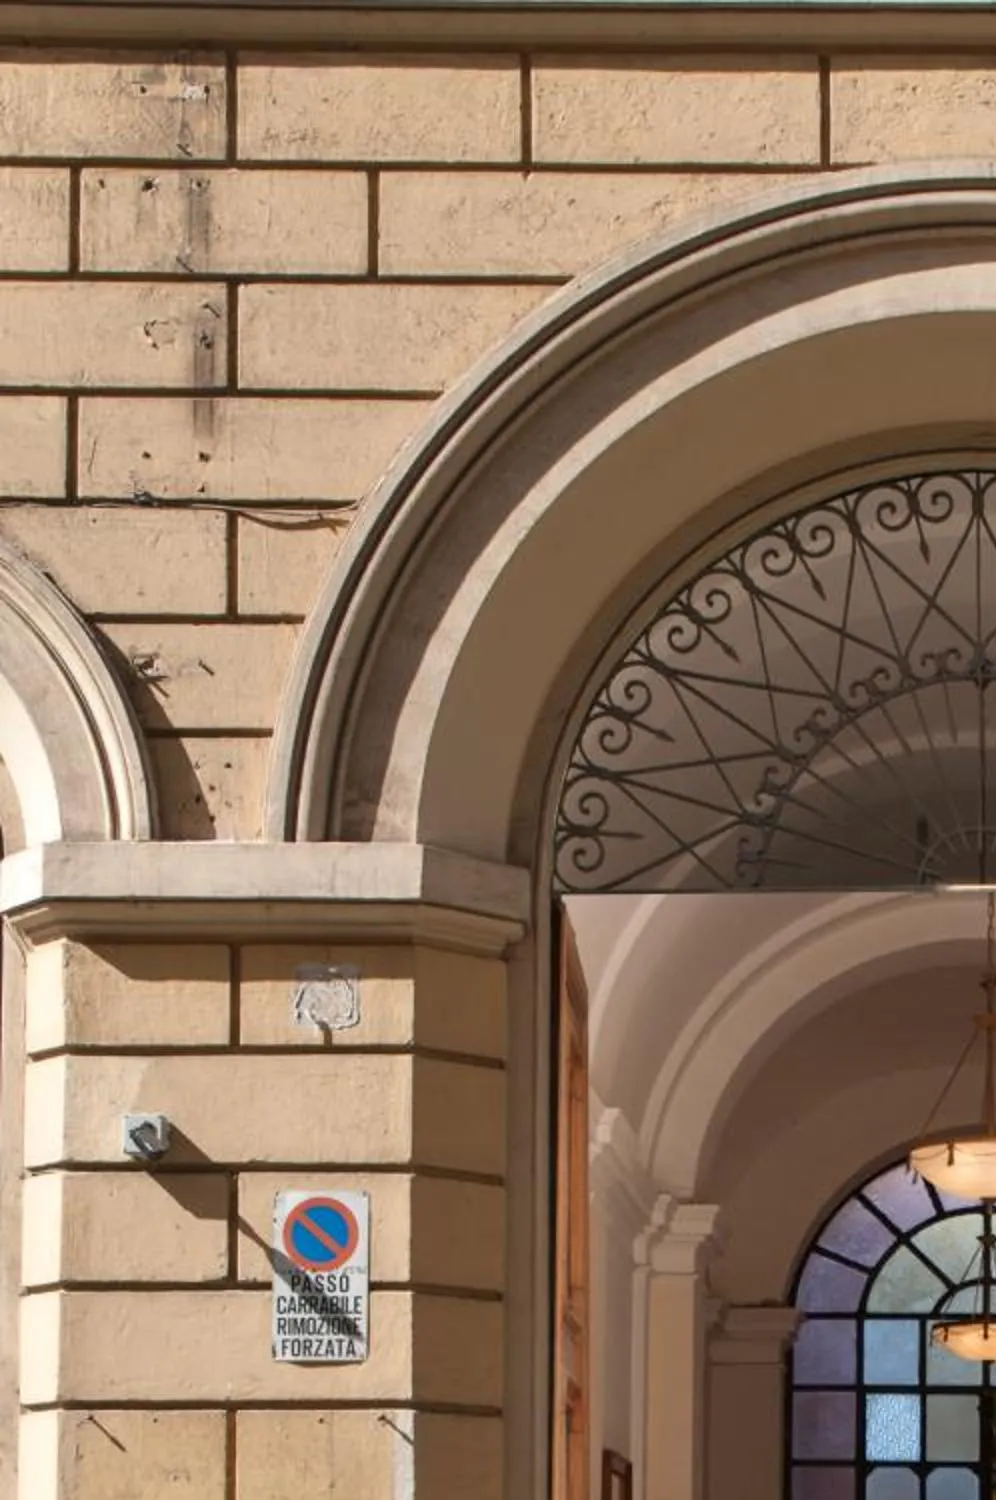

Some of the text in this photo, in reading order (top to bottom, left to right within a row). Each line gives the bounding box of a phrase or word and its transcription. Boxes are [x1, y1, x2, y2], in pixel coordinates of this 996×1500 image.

[291, 1273, 350, 1294] PASSO
[276, 1295, 363, 1315] CARRABILE
[276, 1317, 363, 1336] RIMOZIONE
[281, 1338, 357, 1358] FORZATA
